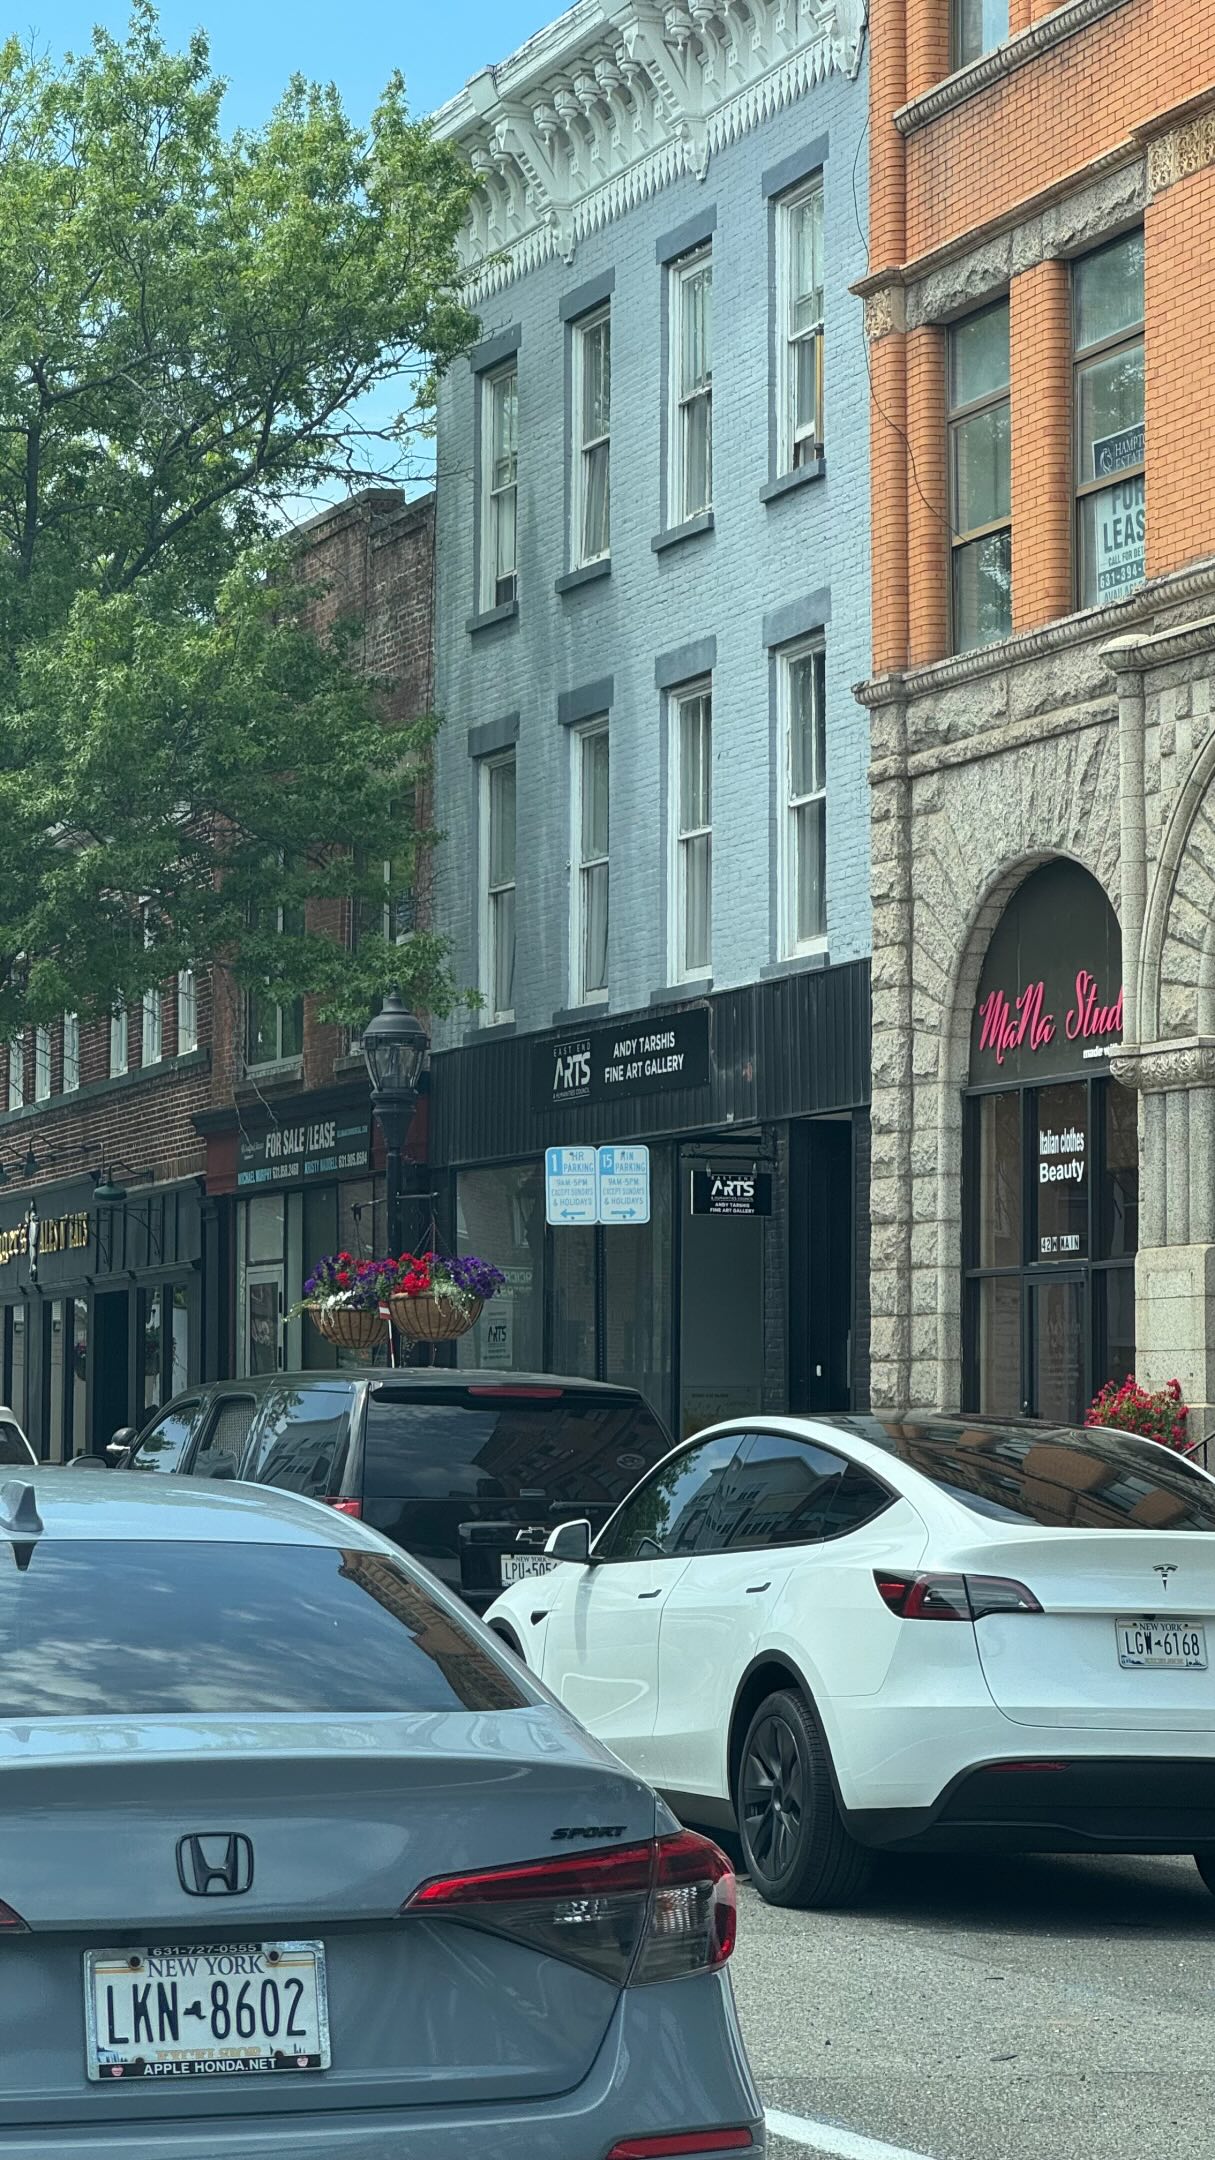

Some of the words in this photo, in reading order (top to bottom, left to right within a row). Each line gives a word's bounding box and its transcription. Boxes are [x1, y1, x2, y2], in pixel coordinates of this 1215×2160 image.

[979, 981, 1057, 1065] MaNa
[553, 1046, 572, 1057] EAST
[577, 1042, 591, 1053] END
[613, 1038, 638, 1058] ANDY
[639, 1032, 676, 1052] TARSHIS
[553, 1051, 591, 1090] ARTS
[604, 1064, 624, 1083] FINE
[625, 1062, 643, 1080] ART
[644, 1053, 685, 1076] GALLERY
[265, 1132, 281, 1159] FOR
[283, 1127, 305, 1156] SALE
[1039, 1129, 1059, 1155] Italian
[1060, 1126, 1085, 1153] clothes
[551, 1154, 557, 1172] 1
[571, 1152, 584, 1160] HR
[564, 1163, 593, 1173] PARKING
[603, 1154, 612, 1169] 15
[615, 1163, 646, 1173] PARKING
[1039, 1158, 1085, 1183] Beauty
[711, 1180, 755, 1197] ARTS
[611, 1197, 644, 1205] HOLIDAYS
[1060, 1235, 1079, 1250] MAIN
[505, 1562, 525, 1580] LPU
[1139, 1622, 1160, 1631] NEW
[1161, 1623, 1183, 1632] YORK
[550, 1826, 628, 1841] SPORT
[153, 1944, 257, 1956] 631-727-0555
[147, 1957, 198, 1978] NEW
[204, 1954, 265, 1976] YORK
[143, 2062, 190, 2075] APPLE
[194, 2058, 277, 2073] HONDA.NET
